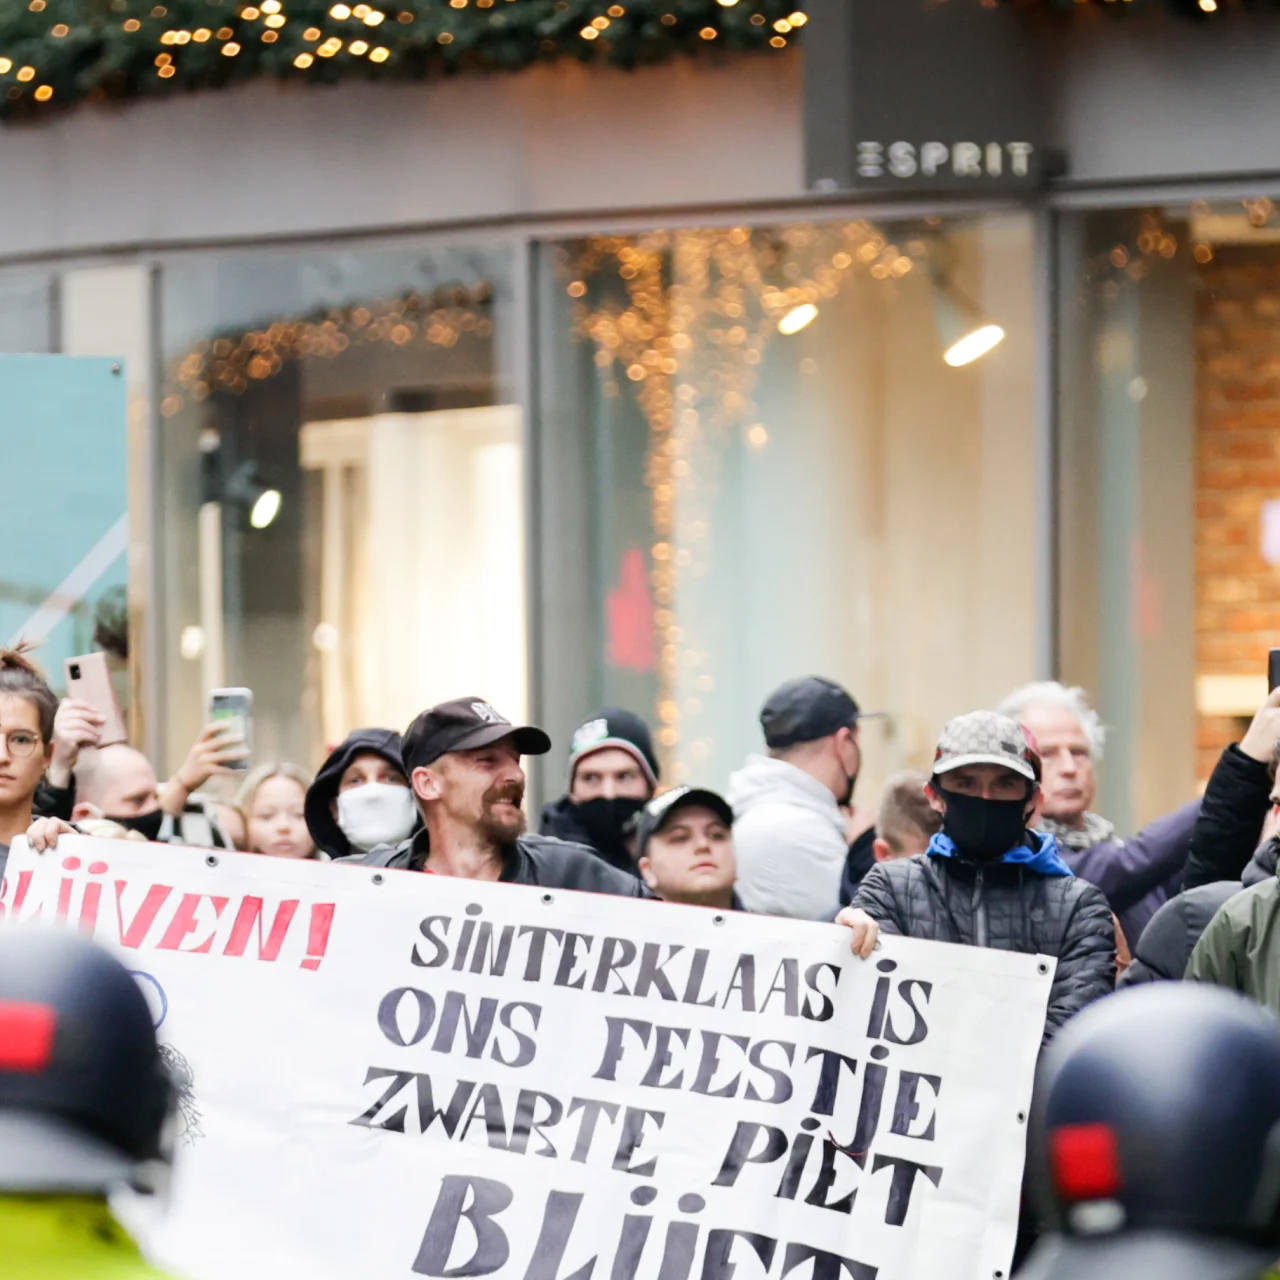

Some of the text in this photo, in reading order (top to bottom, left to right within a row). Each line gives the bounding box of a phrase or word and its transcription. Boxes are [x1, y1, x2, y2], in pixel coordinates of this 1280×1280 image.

[856, 140, 1034, 178] ESPRIT
[376, 986, 543, 1068] ONS
[347, 1066, 666, 1177] ZWARTE
